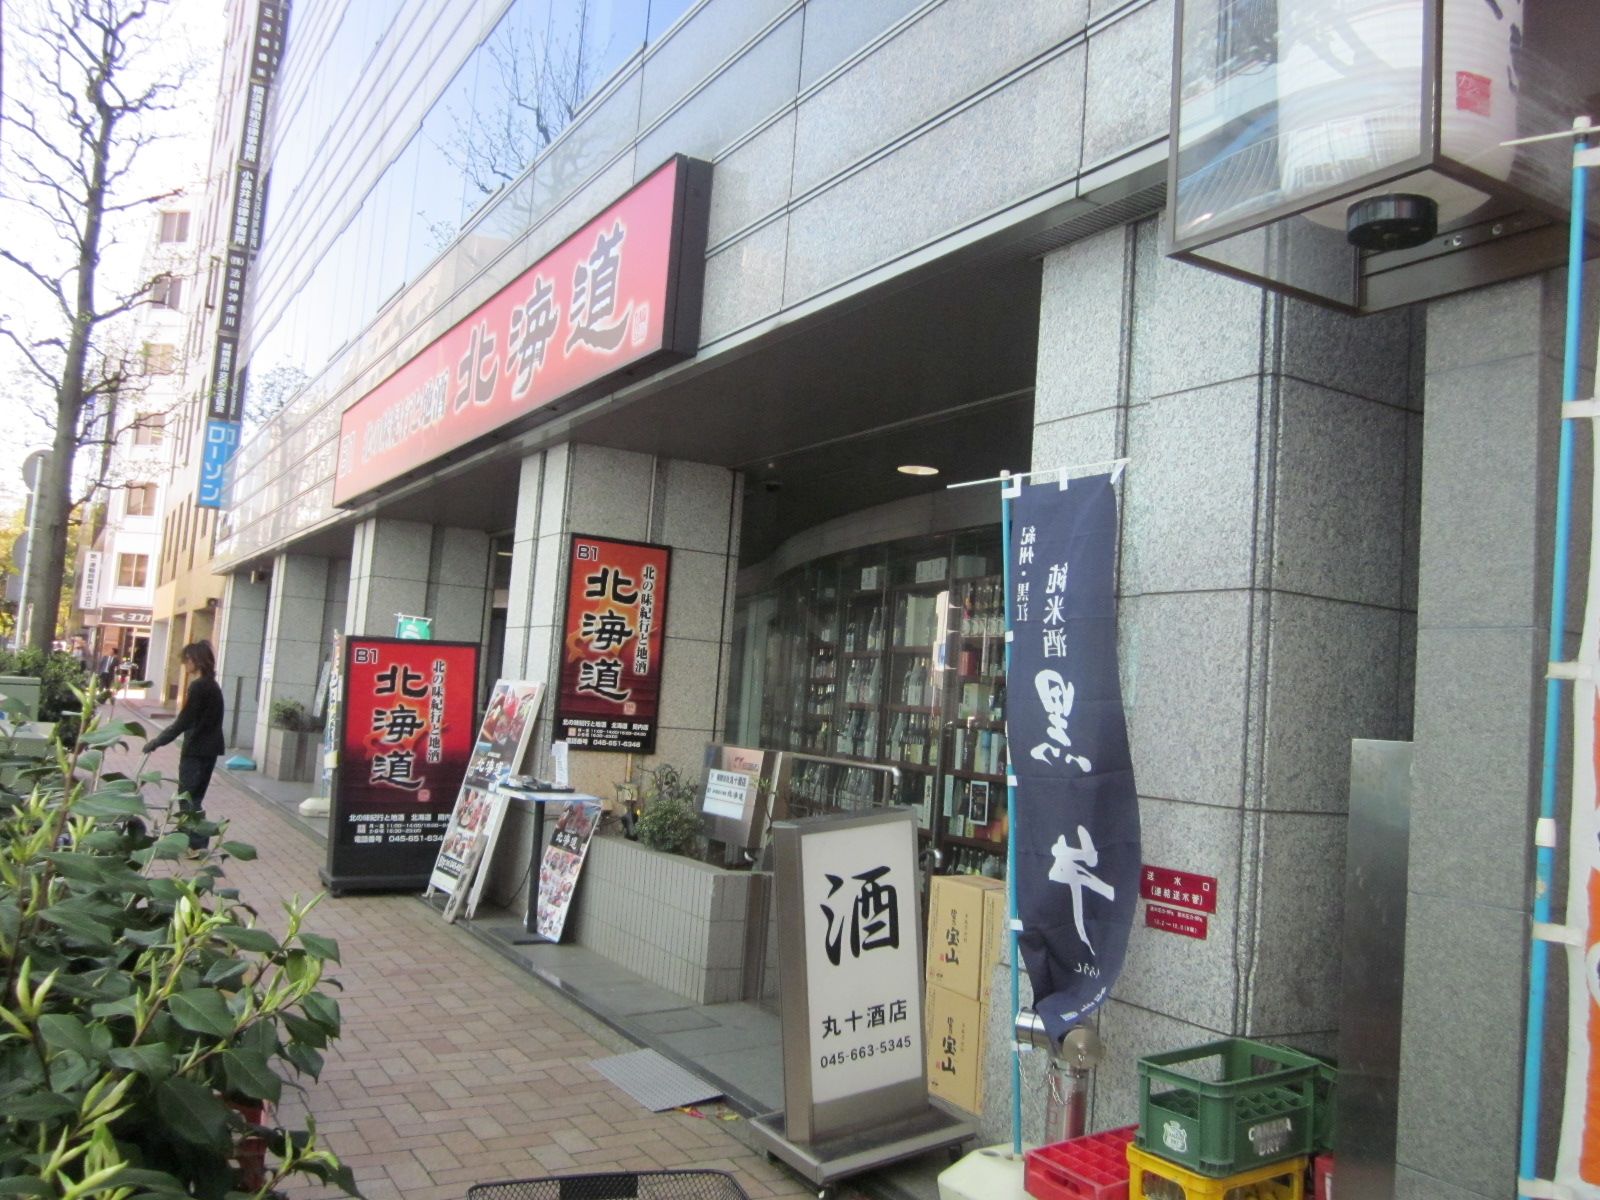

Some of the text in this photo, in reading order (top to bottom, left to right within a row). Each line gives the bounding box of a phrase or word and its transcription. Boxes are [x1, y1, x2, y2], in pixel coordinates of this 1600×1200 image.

[454, 218, 632, 412] 北海道
[201, 425, 226, 501] ローソン
[577, 545, 599, 560] B1
[355, 649, 378, 663] B1
[577, 566, 639, 702] 北海道
[633, 564, 656, 675] 北の味紀行と地酒
[370, 665, 429, 790] 北海道
[427, 660, 444, 762] 北の味紀行と地酒
[820, 865, 900, 967] 酒
[820, 1035, 912, 1069] 045-663-5345
[821, 999, 908, 1039] 丸十酒店
